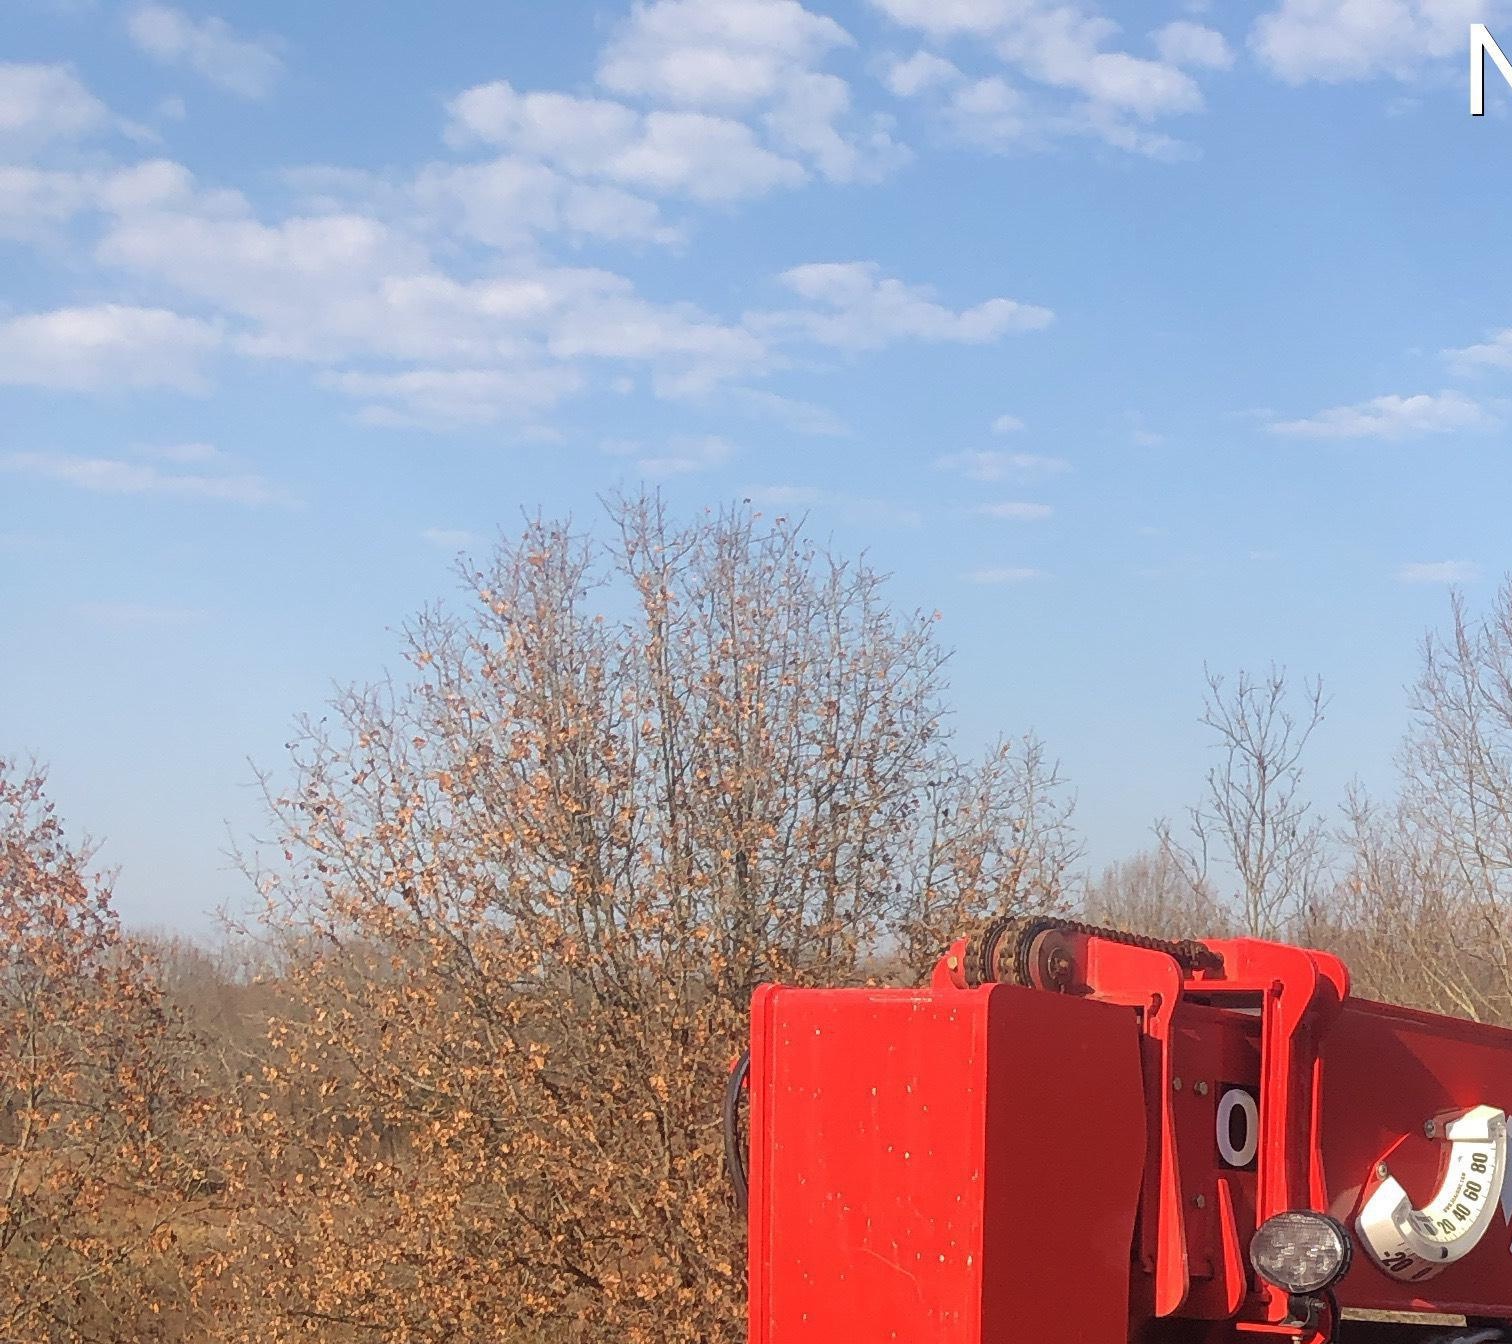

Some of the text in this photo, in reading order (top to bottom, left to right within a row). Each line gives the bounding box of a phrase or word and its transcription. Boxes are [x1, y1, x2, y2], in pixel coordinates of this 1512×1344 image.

[1216, 1088, 1259, 1167] 0
[1470, 1152, 1488, 1174] 80
[1463, 1180, 1482, 1202] 60
[1451, 1203, 1471, 1222] 40
[1436, 1218, 1456, 1235] 20
